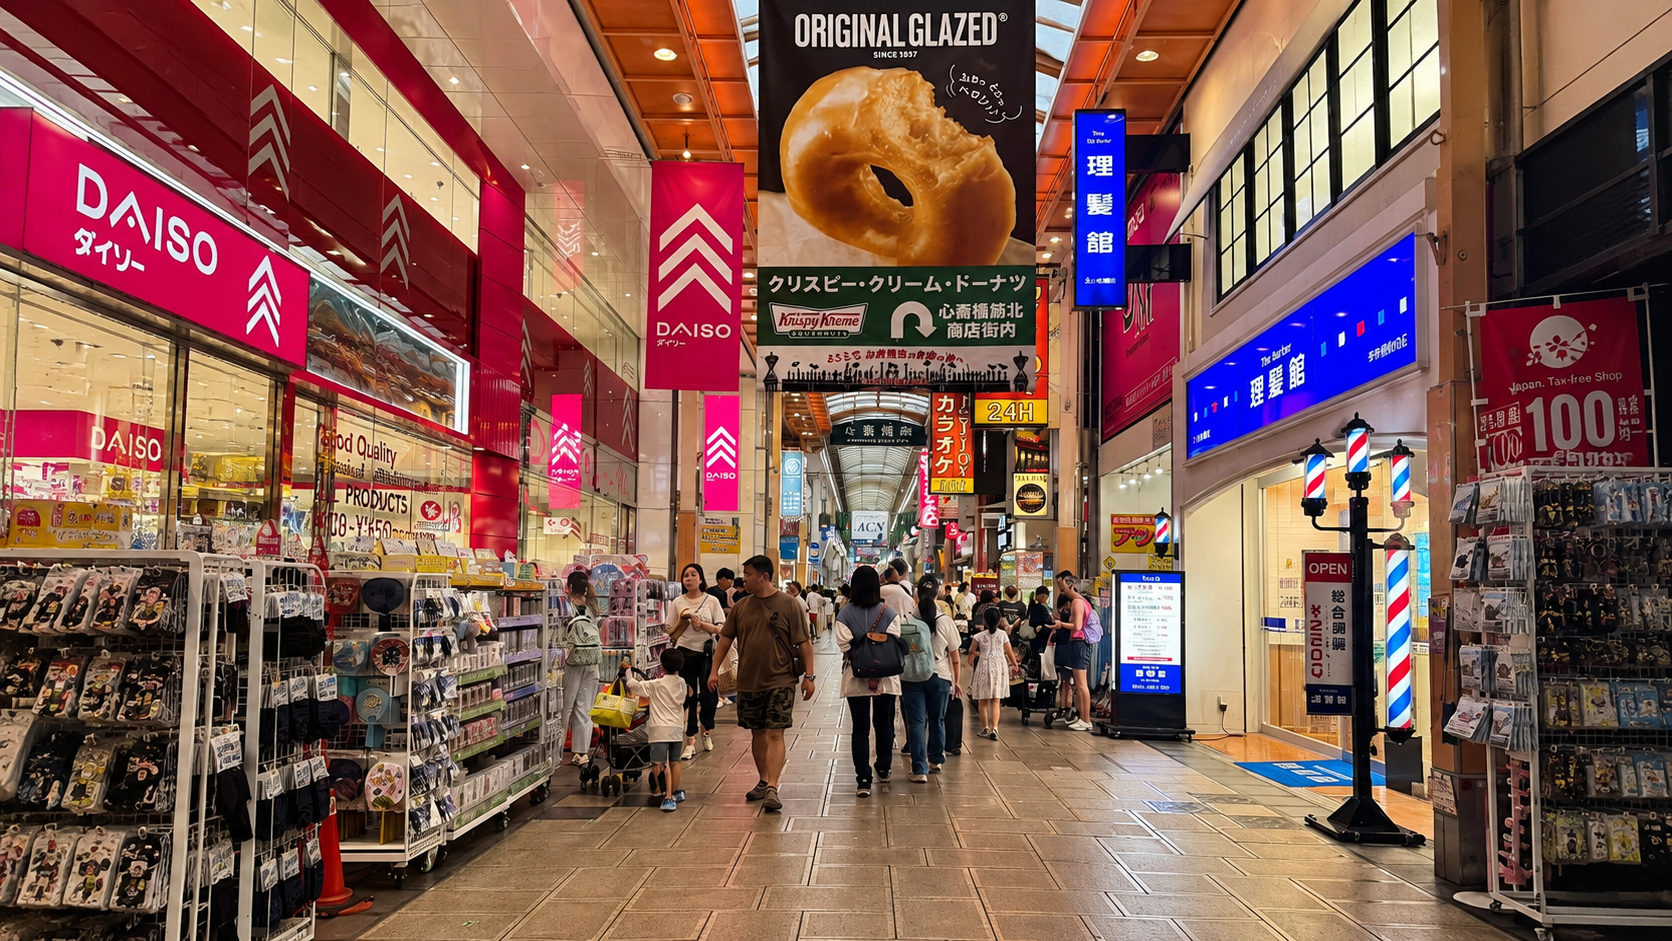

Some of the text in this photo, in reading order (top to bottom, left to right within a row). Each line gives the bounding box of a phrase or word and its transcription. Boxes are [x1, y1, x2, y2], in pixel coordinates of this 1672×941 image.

[795, 13, 906, 48] ORIGINAL
[873, 51, 898, 59] SINCE
[76, 163, 218, 275] DAISO
[74, 228, 145, 272] ダイソー
[768, 275, 1027, 293] クリスピー・クリーム・ドーナツ
[656, 321, 732, 339] DAISO
[779, 313, 860, 330] Krispy Kreme
[1547, 373, 1592, 388] Tax-free
[1595, 371, 1623, 384] Shop
[987, 402, 1034, 422] 24H
[1525, 390, 1616, 452] 100
[91, 426, 162, 461] DAISO
[935, 395, 955, 474] カラオケ
[706, 472, 736, 480] DAISO
[346, 484, 408, 515] PRODUCTS
[1309, 562, 1347, 575] OPEN
